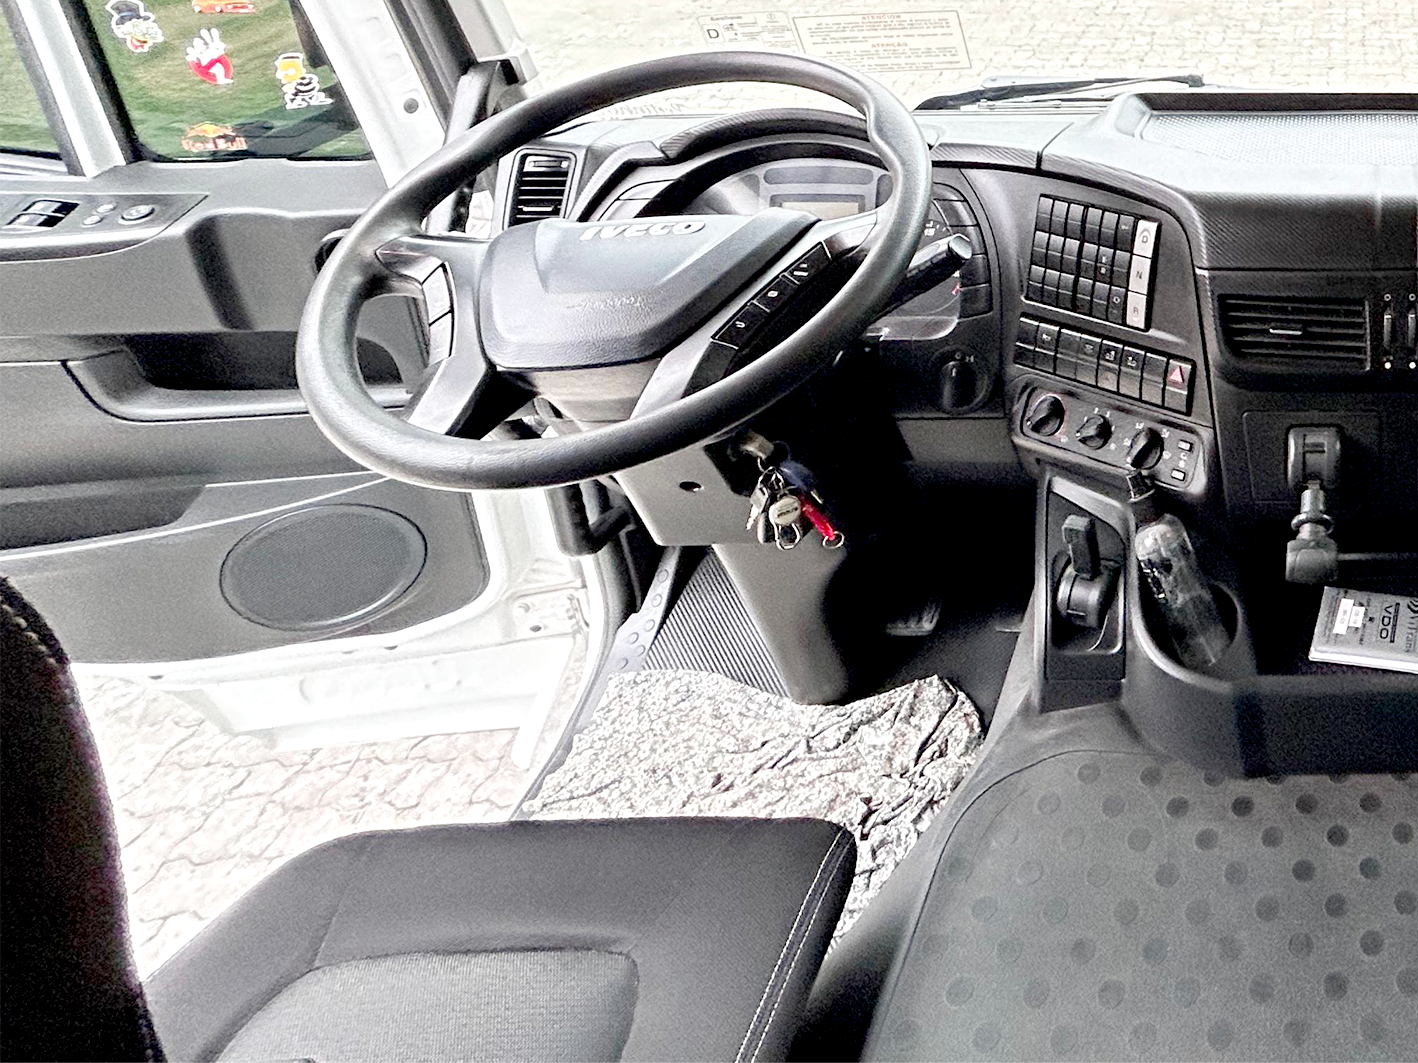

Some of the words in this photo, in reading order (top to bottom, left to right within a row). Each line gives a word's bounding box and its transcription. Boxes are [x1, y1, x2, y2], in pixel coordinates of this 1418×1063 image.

[706, 28, 720, 39] D
[579, 221, 706, 241] IVECO
[1141, 235, 1149, 244] D
[1135, 270, 1143, 280] N
[1380, 604, 1394, 640] VDO
